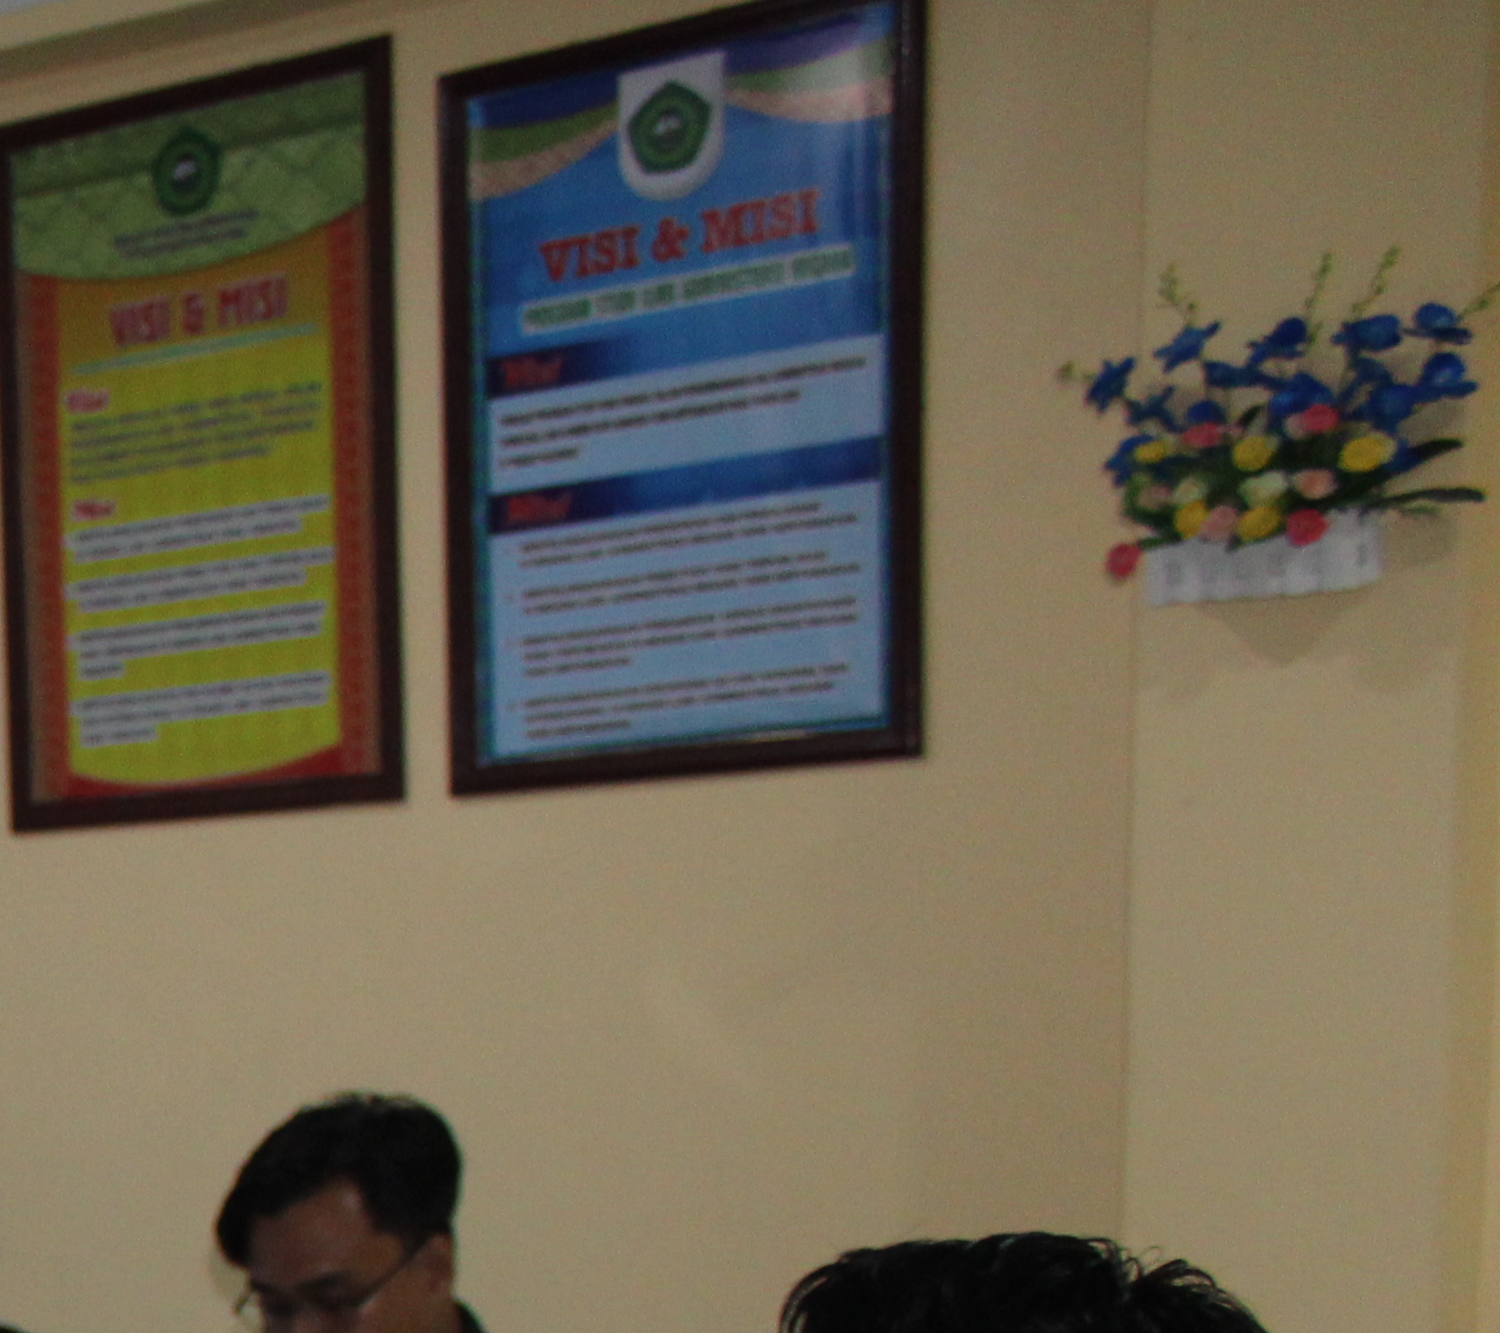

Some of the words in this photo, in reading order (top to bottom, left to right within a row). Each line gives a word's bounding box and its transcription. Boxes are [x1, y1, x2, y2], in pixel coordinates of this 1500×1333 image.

[539, 225, 641, 283] VISI
[651, 216, 690, 262] &
[700, 188, 821, 253] MISI
